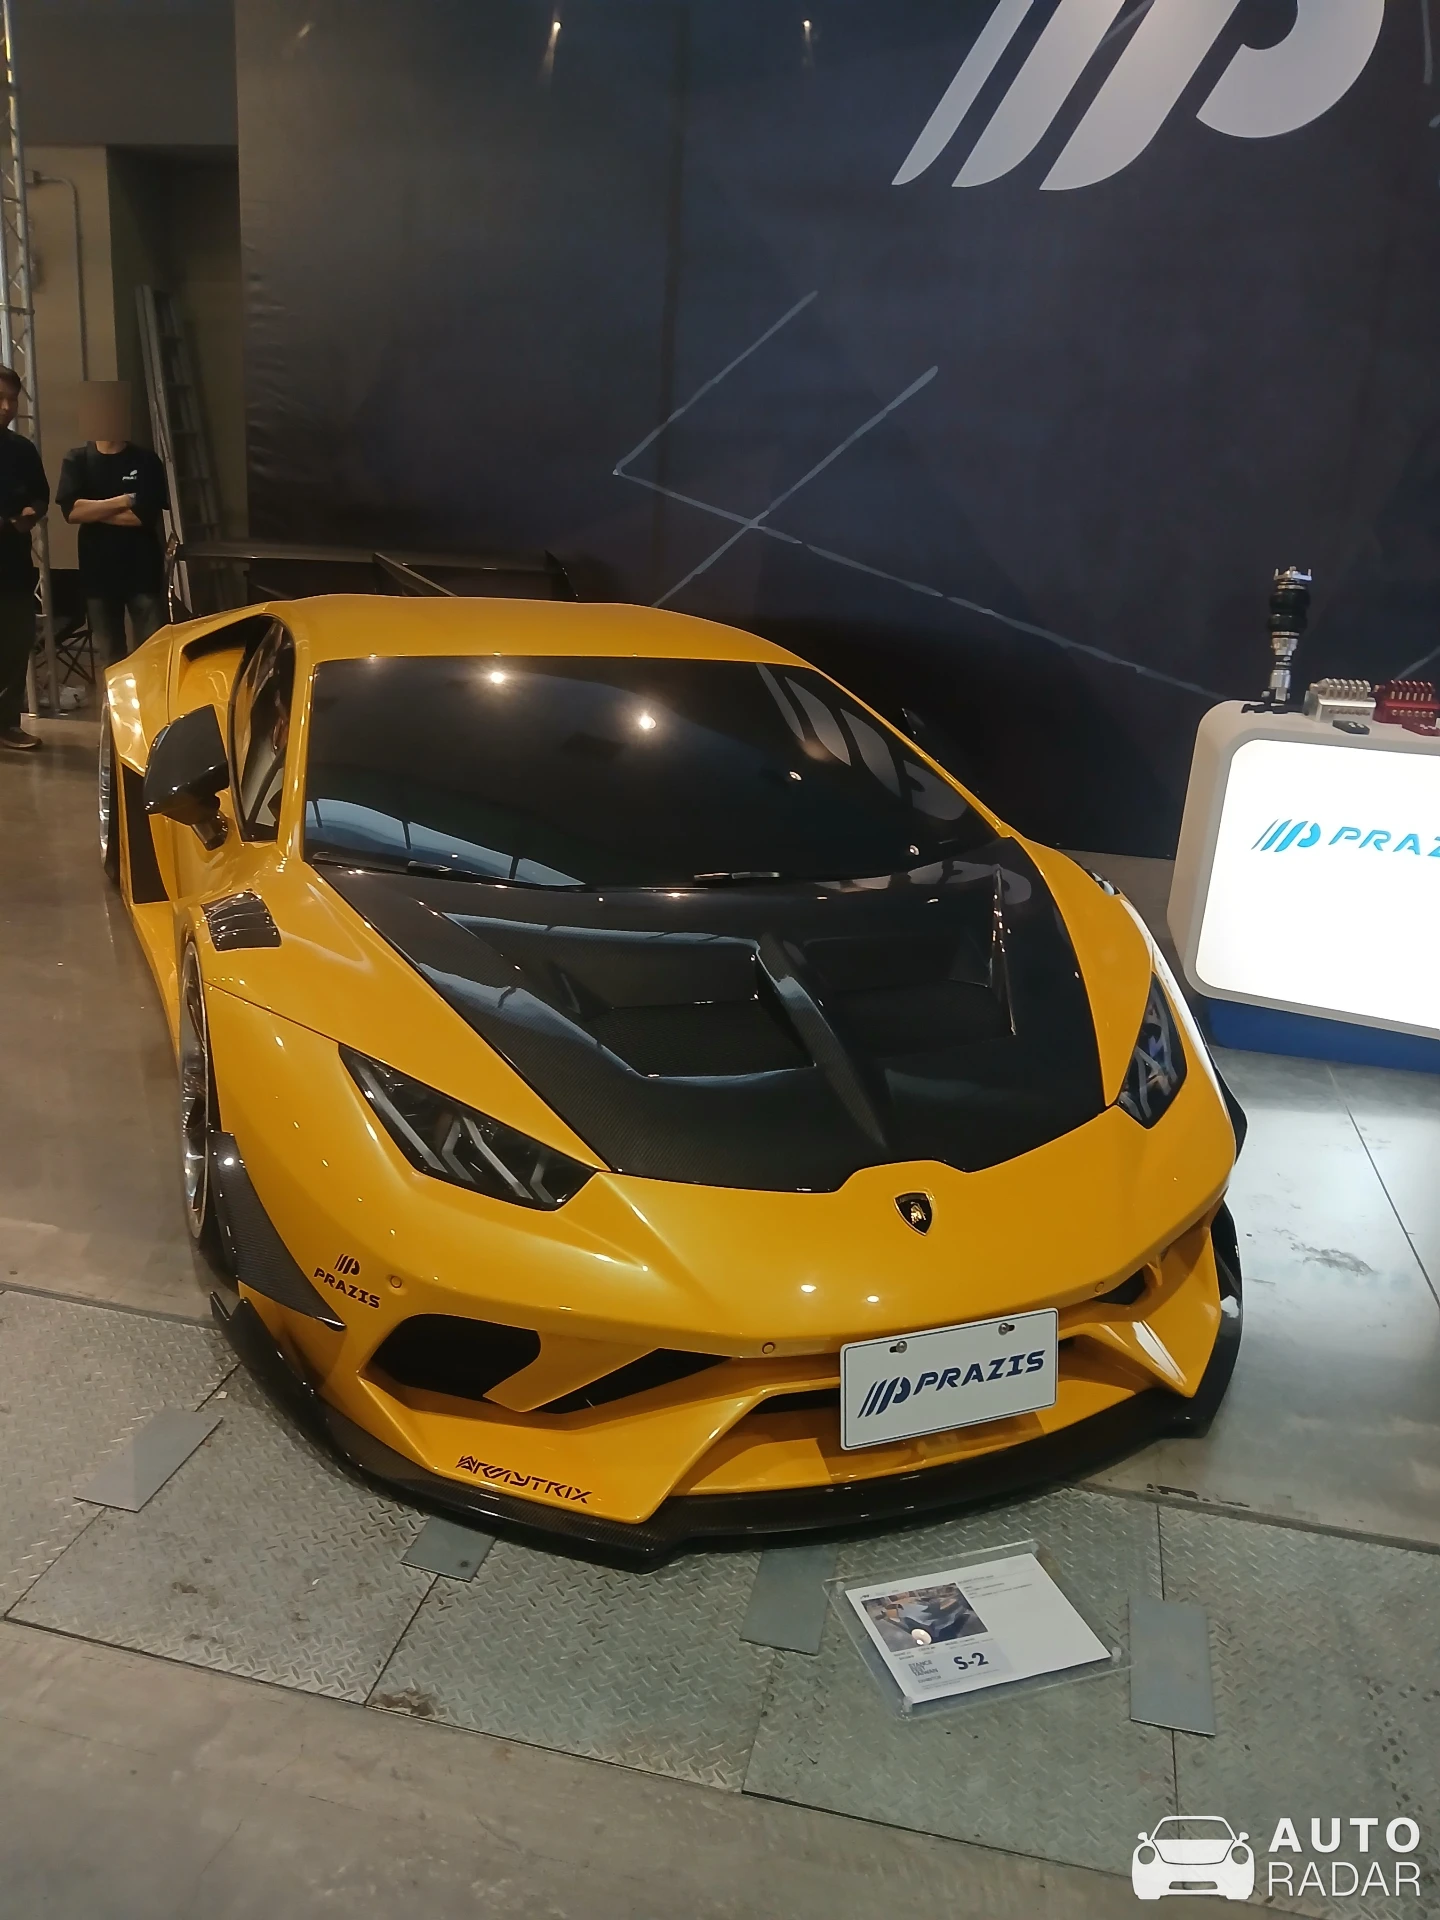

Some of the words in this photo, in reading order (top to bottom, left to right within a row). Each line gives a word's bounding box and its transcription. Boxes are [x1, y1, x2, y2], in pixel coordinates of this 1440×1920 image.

[313, 1267, 381, 1309] PRAZIS
[913, 1349, 1046, 1395] PRAZIS
[953, 1652, 989, 1670] S-2
